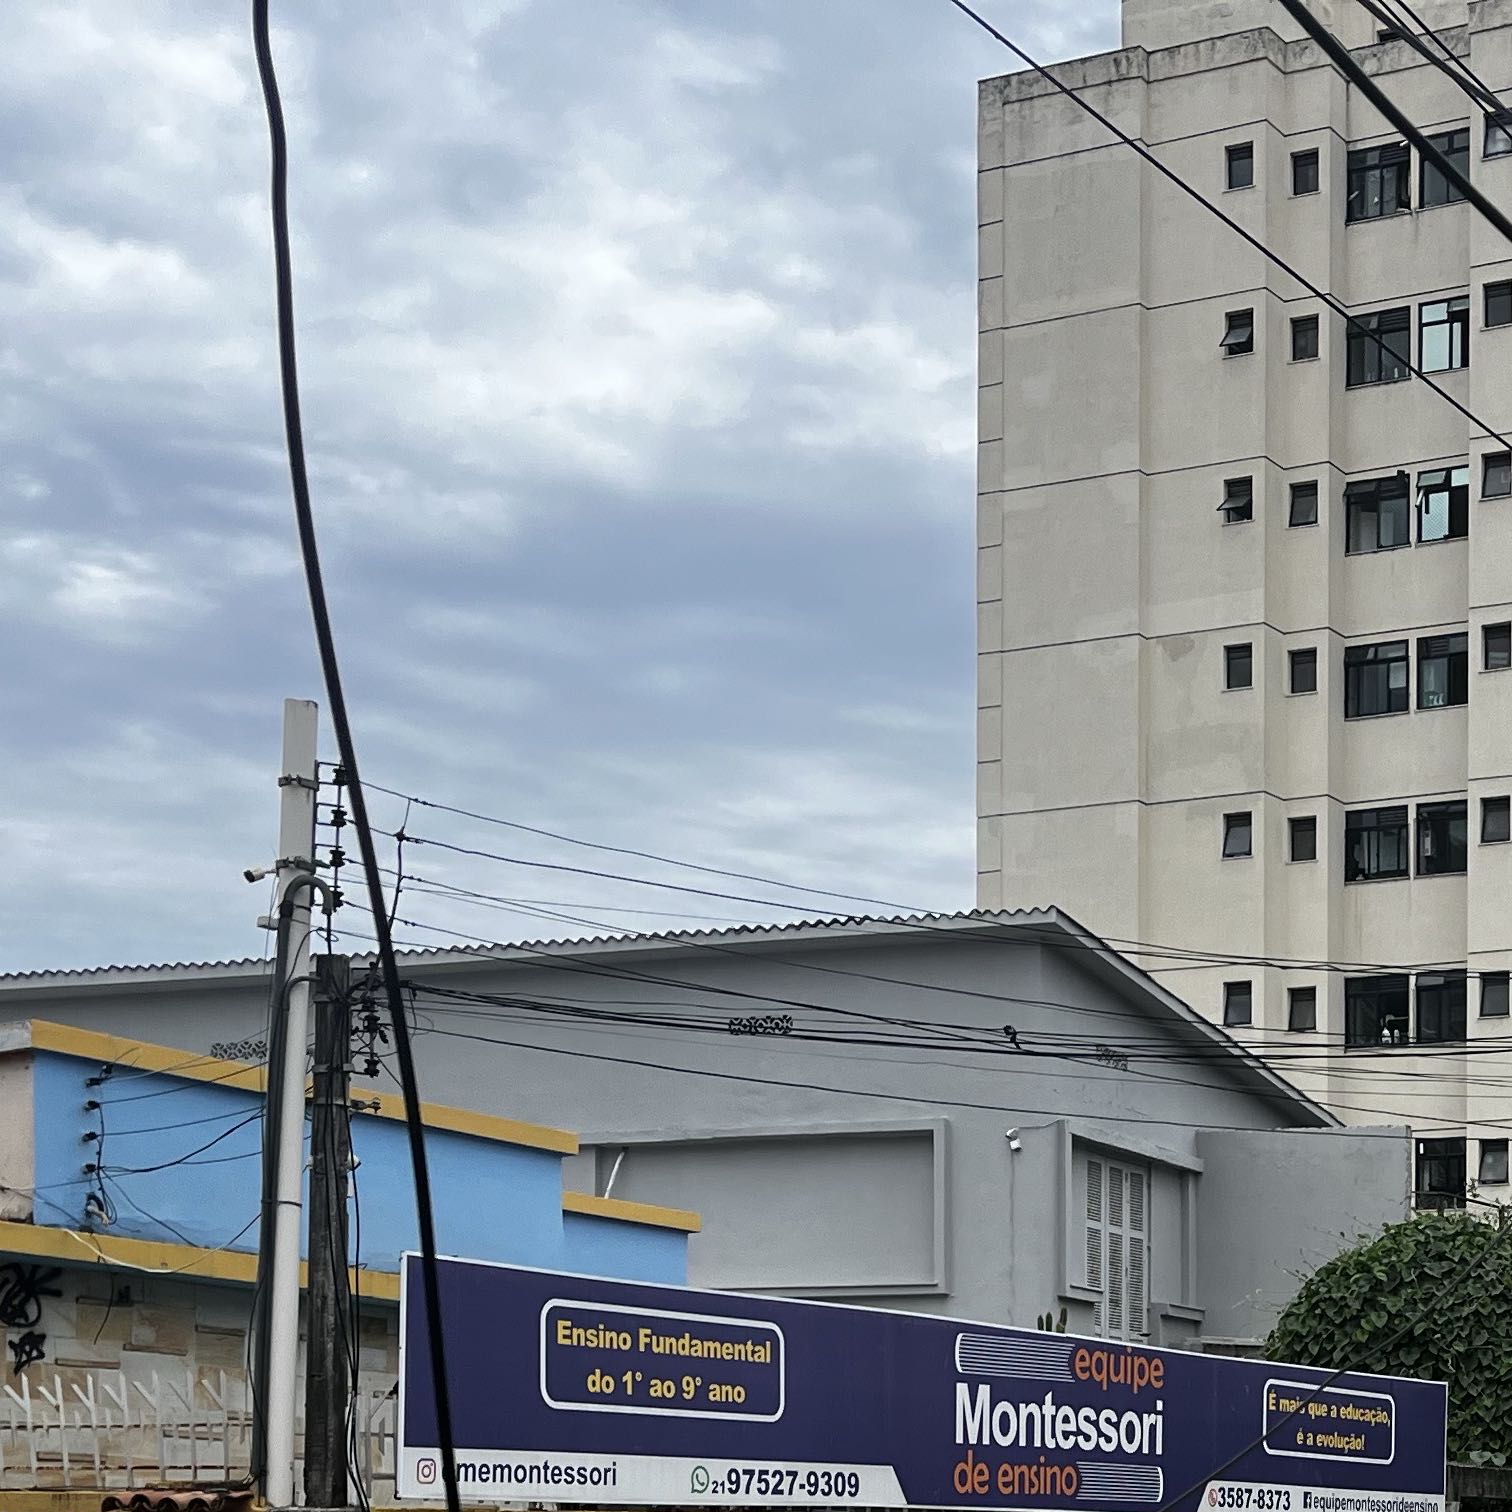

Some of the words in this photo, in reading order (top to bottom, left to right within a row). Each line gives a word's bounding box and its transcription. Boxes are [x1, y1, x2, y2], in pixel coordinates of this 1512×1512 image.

[556, 1319, 632, 1351] Ensino
[638, 1327, 772, 1363] Fundamental
[587, 1368, 615, 1394] do
[649, 1378, 676, 1399] ao
[708, 1382, 746, 1403] ano
[1074, 1347, 1165, 1394] equipe
[955, 1382, 1163, 1455] Montessori
[1268, 1389, 1277, 1411] É
[1308, 1402, 1328, 1420] que
[1330, 1404, 1337, 1418] a
[1339, 1403, 1391, 1427] educação,
[1296, 1427, 1304, 1445] é
[1306, 1433, 1314, 1446] a
[1316, 1432, 1366, 1453] evolução!
[442, 1459, 617, 1486] memontessori
[727, 1468, 860, 1497] 97527-9309
[954, 1450, 990, 1494] de
[997, 1455, 1077, 1496] ensino
[1217, 1487, 1291, 1511] 3587-8373
